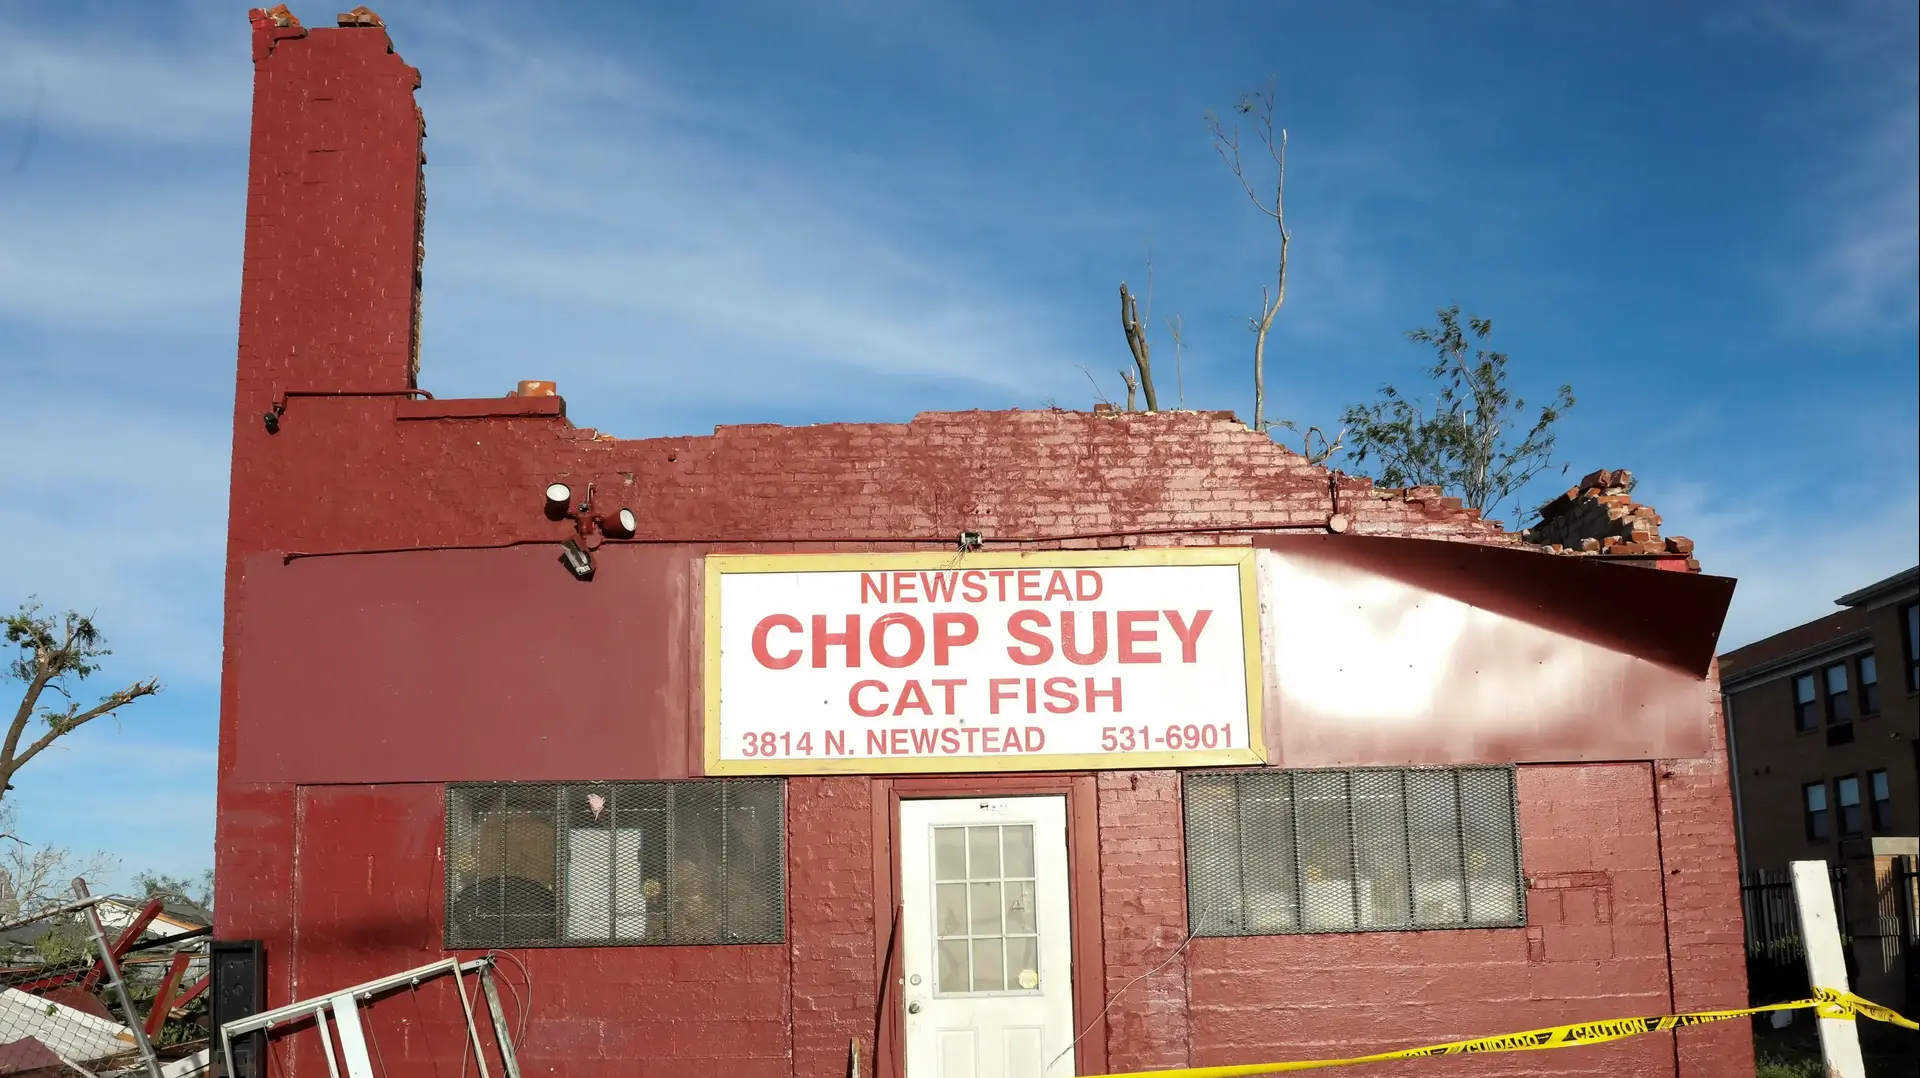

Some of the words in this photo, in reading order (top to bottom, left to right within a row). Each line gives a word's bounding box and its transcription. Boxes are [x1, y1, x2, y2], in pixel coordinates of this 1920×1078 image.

[861, 570, 1102, 604] NEWSTEAD
[752, 612, 978, 670] CHOP
[1008, 609, 1211, 665] SUEY
[849, 679, 967, 717] CAT
[990, 677, 1122, 714] FISH
[742, 732, 813, 756] 3814
[825, 730, 853, 755] N.
[867, 727, 1045, 754] NEWSTEAD
[1101, 725, 1231, 751] 531-6901
[1466, 1034, 1539, 1053] CUIDADO
[1572, 1018, 1649, 1041] CAUTION
